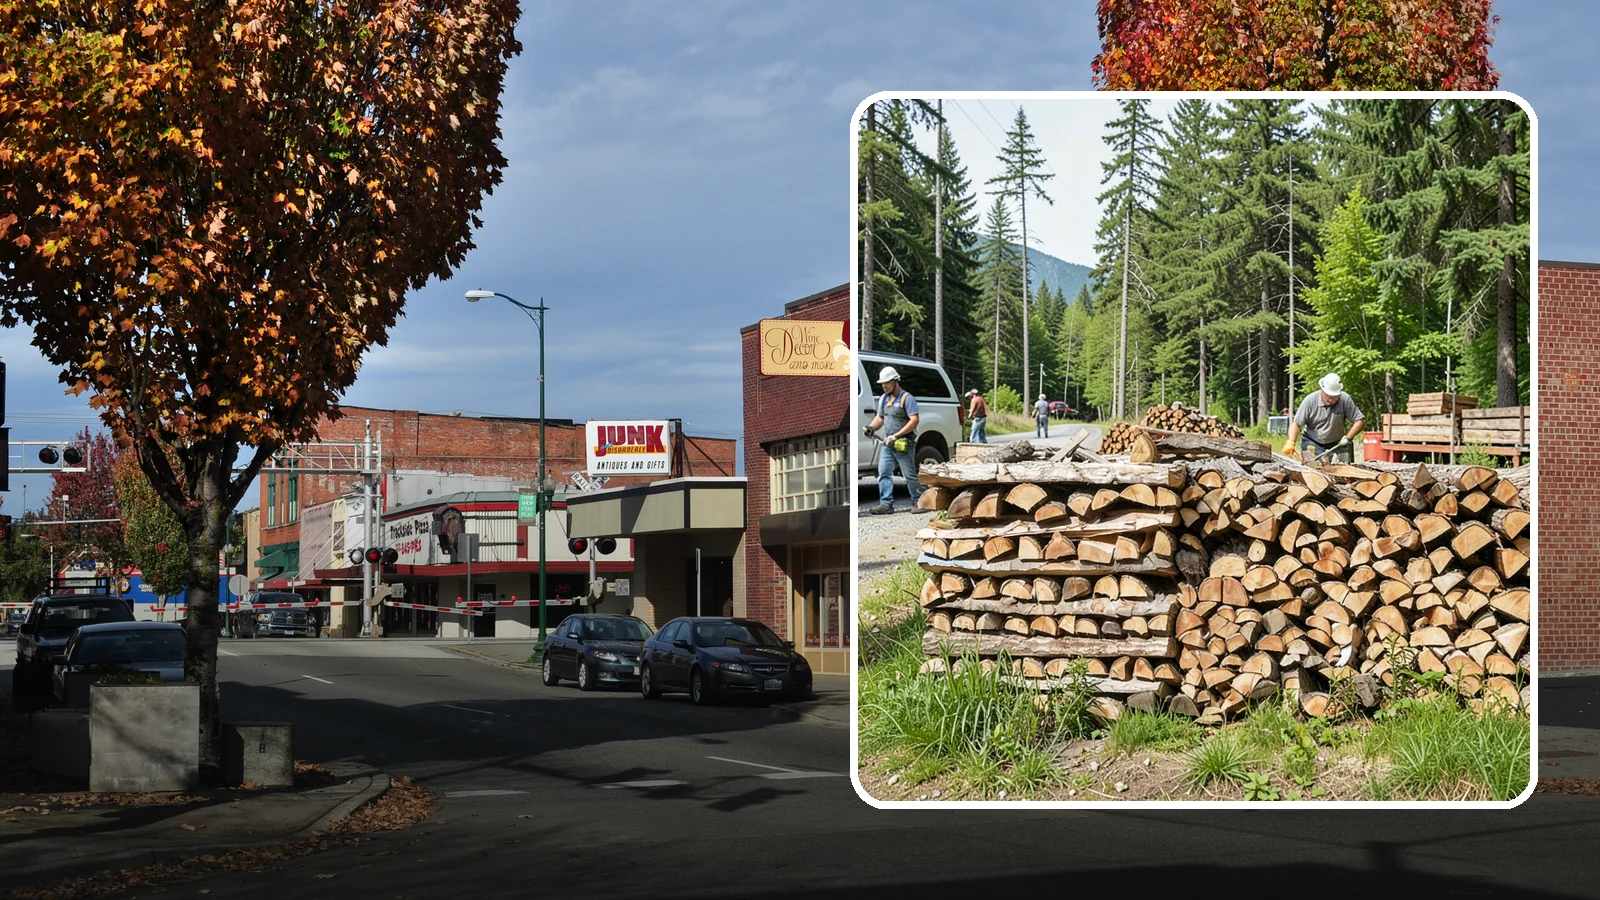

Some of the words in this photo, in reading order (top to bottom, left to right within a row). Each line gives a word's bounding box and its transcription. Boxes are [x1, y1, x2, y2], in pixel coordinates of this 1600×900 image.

[791, 325, 825, 345] Wine
[595, 425, 665, 457] JUNK
[607, 446, 645, 454] DISORDERLY
[597, 461, 628, 470] ANTIQUES
[631, 461, 644, 469] AND
[647, 460, 665, 469] GIFTS
[390, 521, 412, 540] Trackside
[415, 519, 429, 535] Pizza
